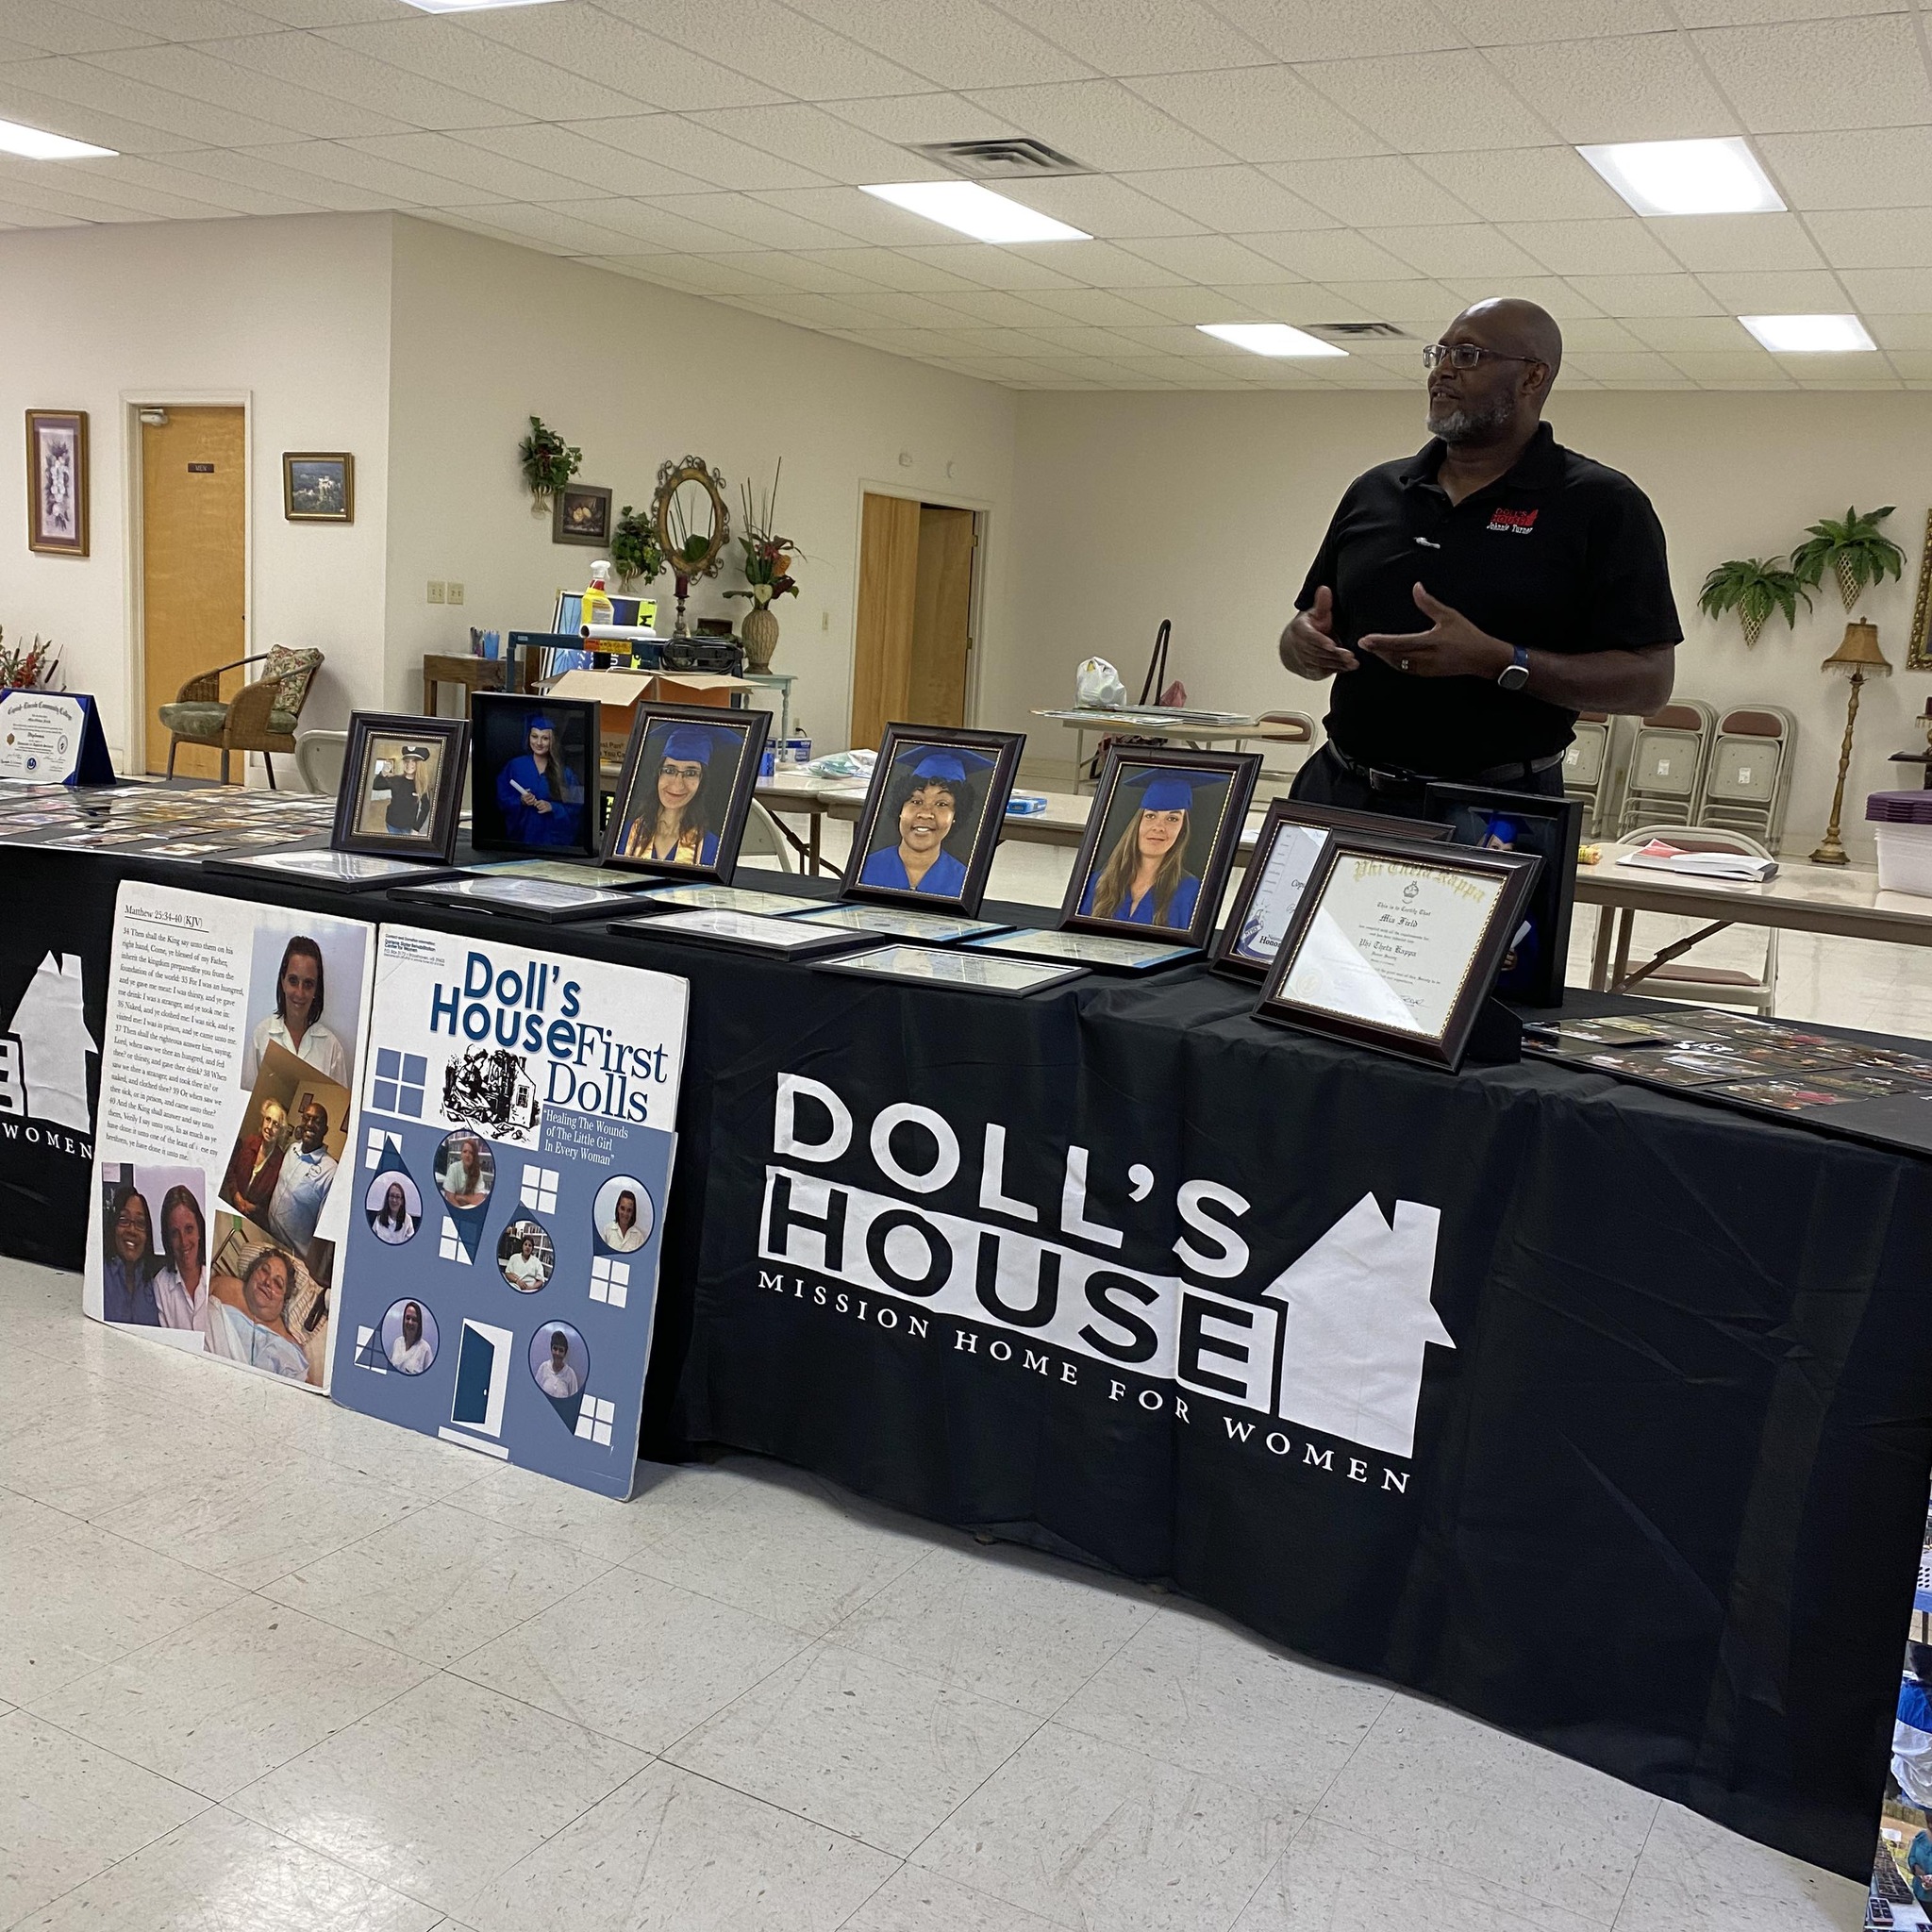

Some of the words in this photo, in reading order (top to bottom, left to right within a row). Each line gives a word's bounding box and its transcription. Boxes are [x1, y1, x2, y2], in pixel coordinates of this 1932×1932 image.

[125, 905, 153, 918] Matthew
[154, 909, 182, 923] 25:34-40
[1379, 913, 1395, 924] Mia
[1397, 916, 1418, 928] Field
[167, 935, 179, 946] King
[464, 951, 581, 1017] Doll's
[430, 983, 576, 1058] House
[573, 1022, 669, 1083] First
[543, 1060, 649, 1123] Dolls
[2, 1122, 92, 1160] WOMEN
[544, 1140, 553, 1151] In
[555, 1141, 579, 1160] Every
[546, 1125, 557, 1137] of
[557, 1127, 572, 1141] The
[574, 1131, 595, 1146] Little
[596, 1137, 613, 1151] Girl
[578, 1116, 594, 1131] The
[596, 1120, 629, 1139] Wounds
[774, 1072, 1252, 1278] DOLL'S
[764, 1170, 1258, 1400] HOUSE
[758, 1270, 930, 1340] MISSION
[954, 1329, 1079, 1386] HOME
[1108, 1378, 1191, 1424] FOR
[1222, 1416, 1410, 1494] WOMEN
